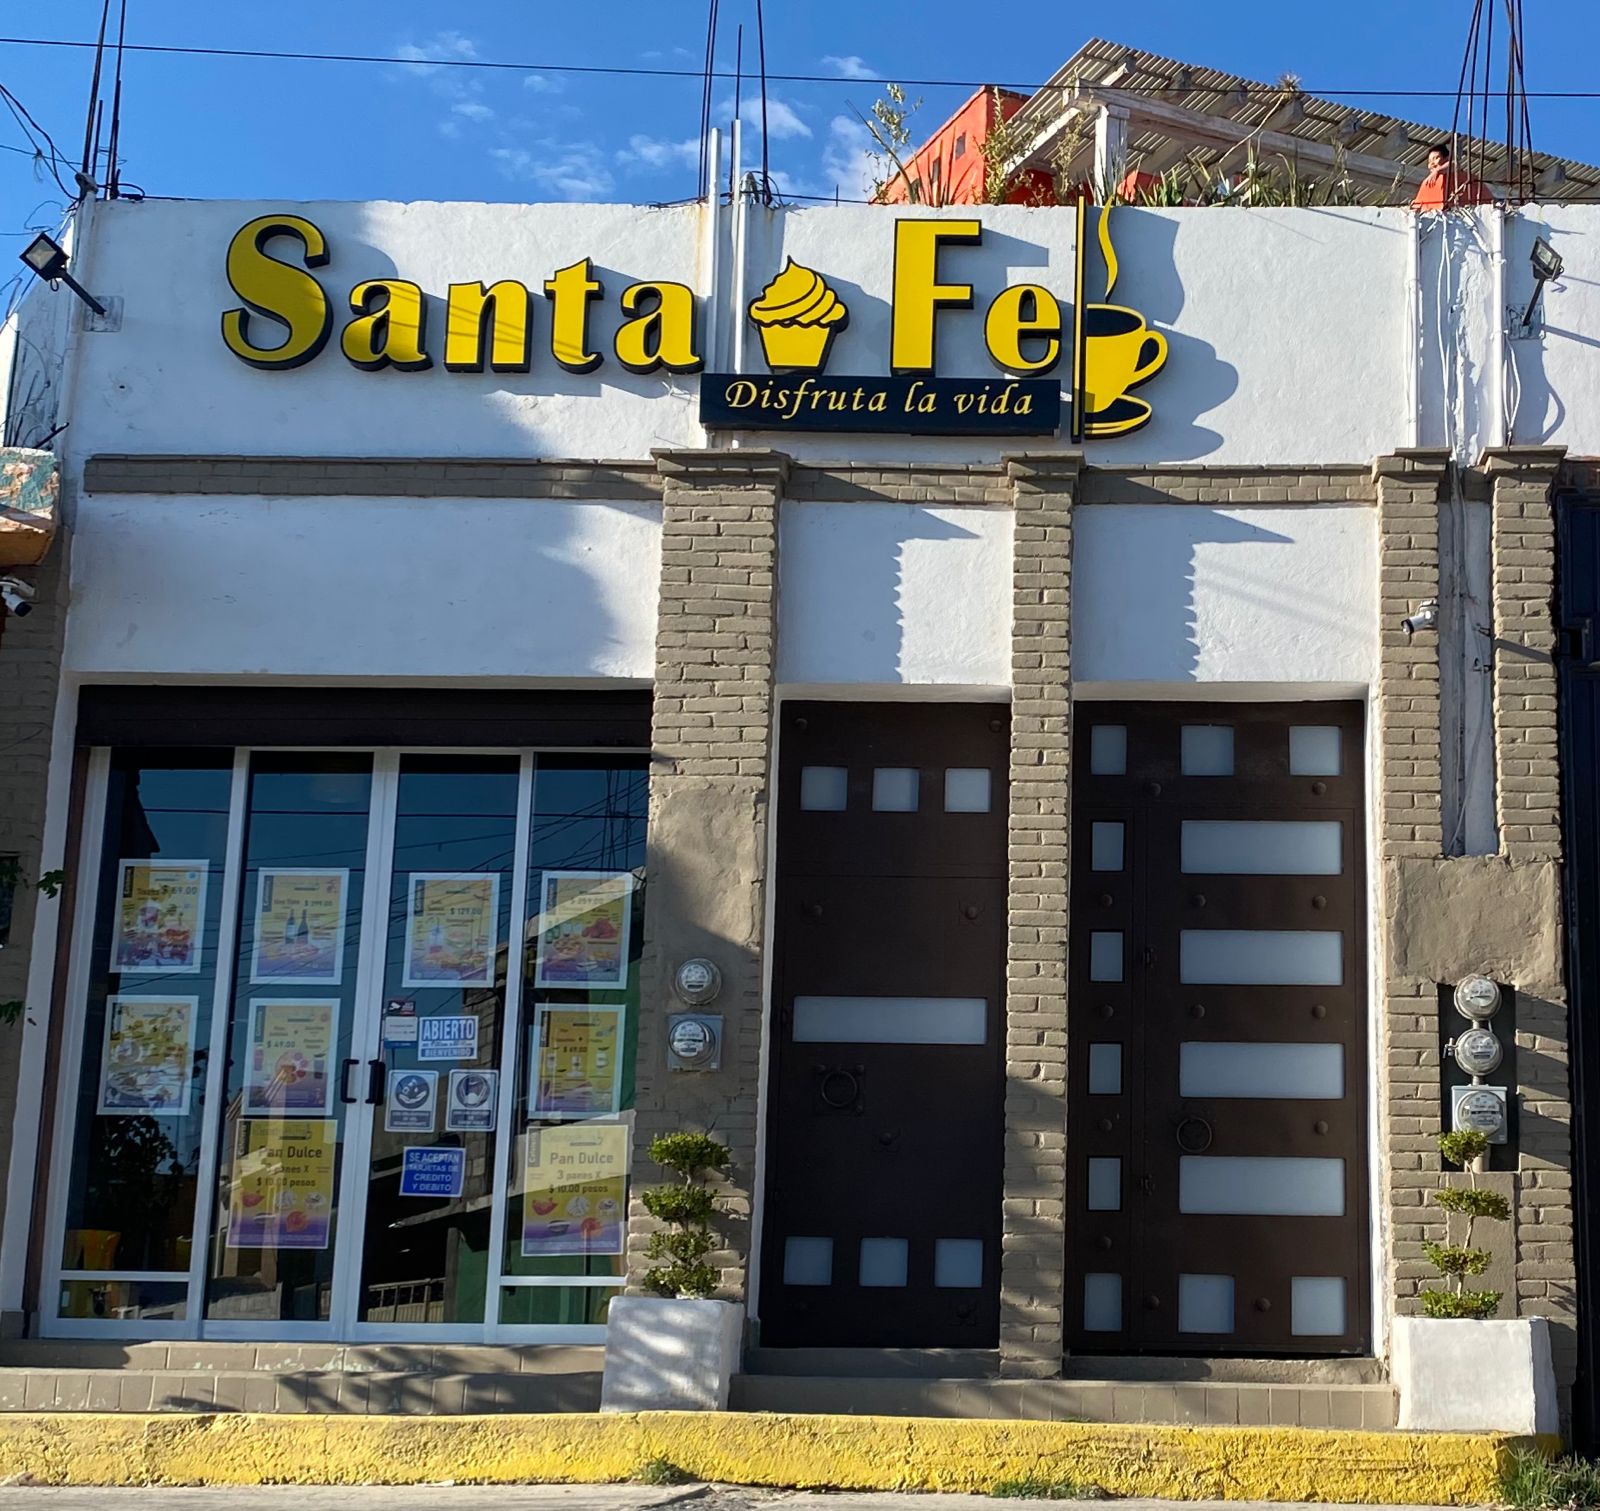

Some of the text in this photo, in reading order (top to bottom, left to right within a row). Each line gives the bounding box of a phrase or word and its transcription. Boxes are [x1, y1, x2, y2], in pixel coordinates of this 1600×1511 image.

[221, 213, 1063, 378] Santa Fe
[725, 379, 1033, 420] Disfruta la vida
[423, 1020, 475, 1040] ABIERTO
[424, 1048, 472, 1057] BIENVENIDO
[287, 1146, 323, 1158] Dulce
[409, 1152, 458, 1162] SE ACEPTAN
[550, 1152, 614, 1164] Pan Dulce
[557, 1170, 564, 1179] 3
[566, 1172, 593, 1181] panes
[257, 1177, 262, 1186] $
[289, 1179, 316, 1188] pesos
[548, 1184, 609, 1194] $ 10.00 pesos
